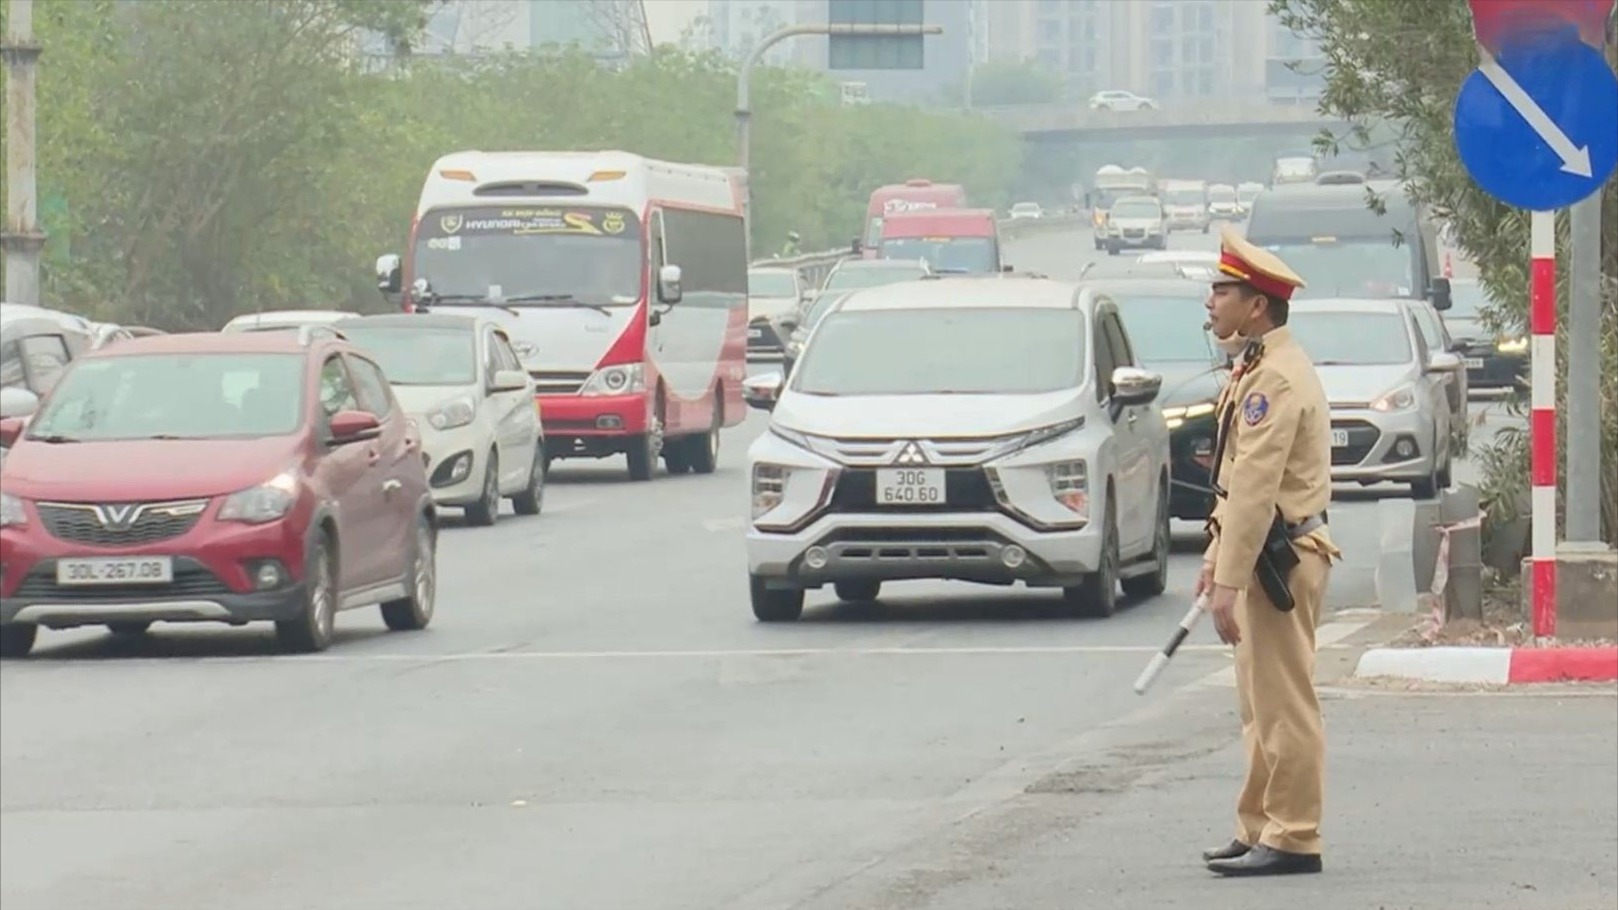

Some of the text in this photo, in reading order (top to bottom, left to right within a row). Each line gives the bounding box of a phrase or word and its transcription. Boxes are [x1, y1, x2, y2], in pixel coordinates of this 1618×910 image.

[896, 470, 926, 486] 30G
[884, 486, 938, 502] 640.60
[67, 561, 163, 580] 30L-267.08
